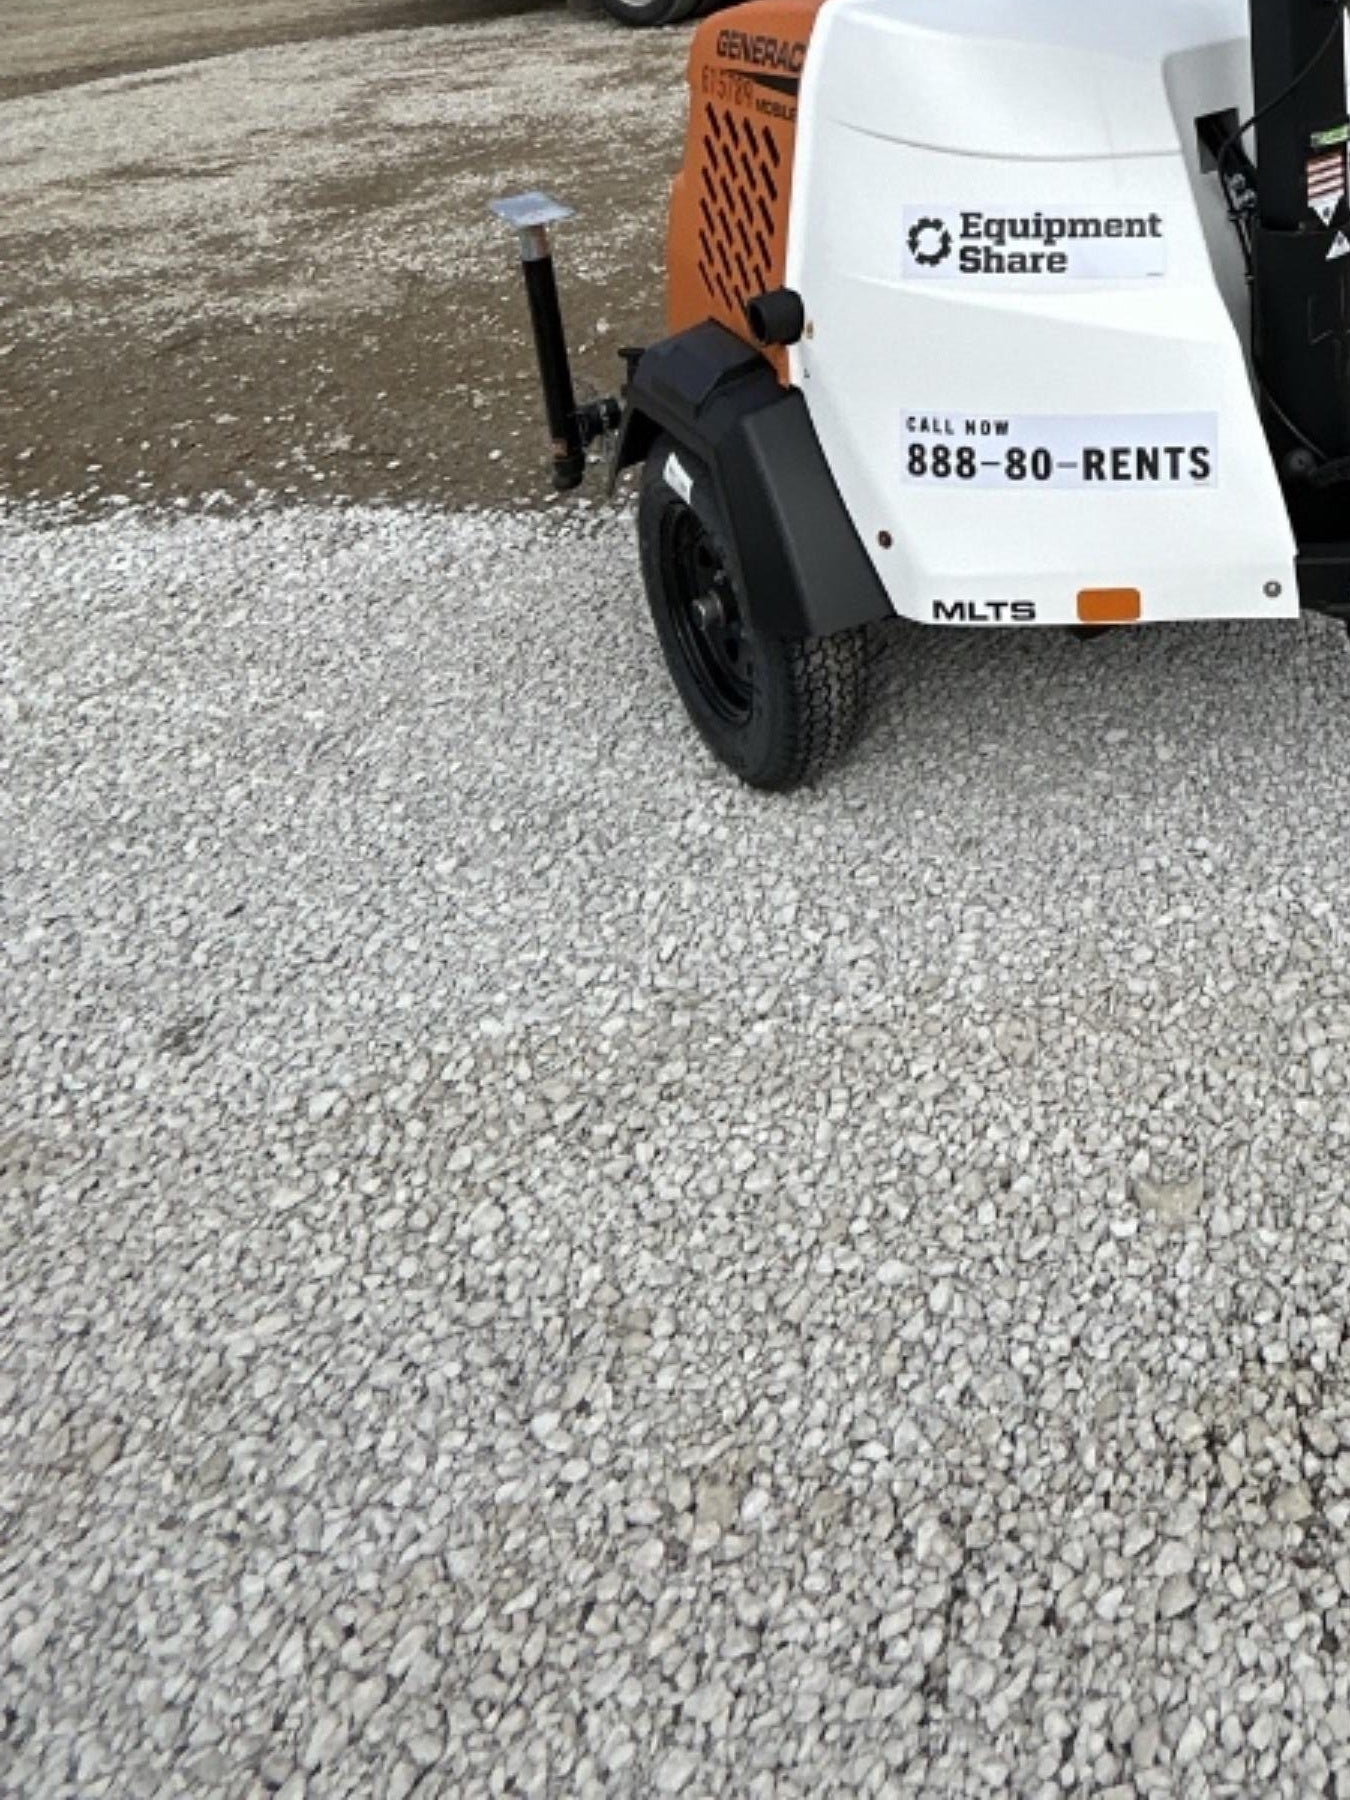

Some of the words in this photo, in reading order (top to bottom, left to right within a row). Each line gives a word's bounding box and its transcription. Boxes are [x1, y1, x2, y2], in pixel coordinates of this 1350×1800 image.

[717, 29, 806, 72] GENERAC
[959, 211, 1163, 246] Equipment
[959, 245, 1068, 274] Share
[904, 415, 955, 435] CALL
[965, 419, 1009, 436] NOW
[907, 442, 1211, 480] 888-80-RENTS
[932, 599, 1036, 621] MLTS
